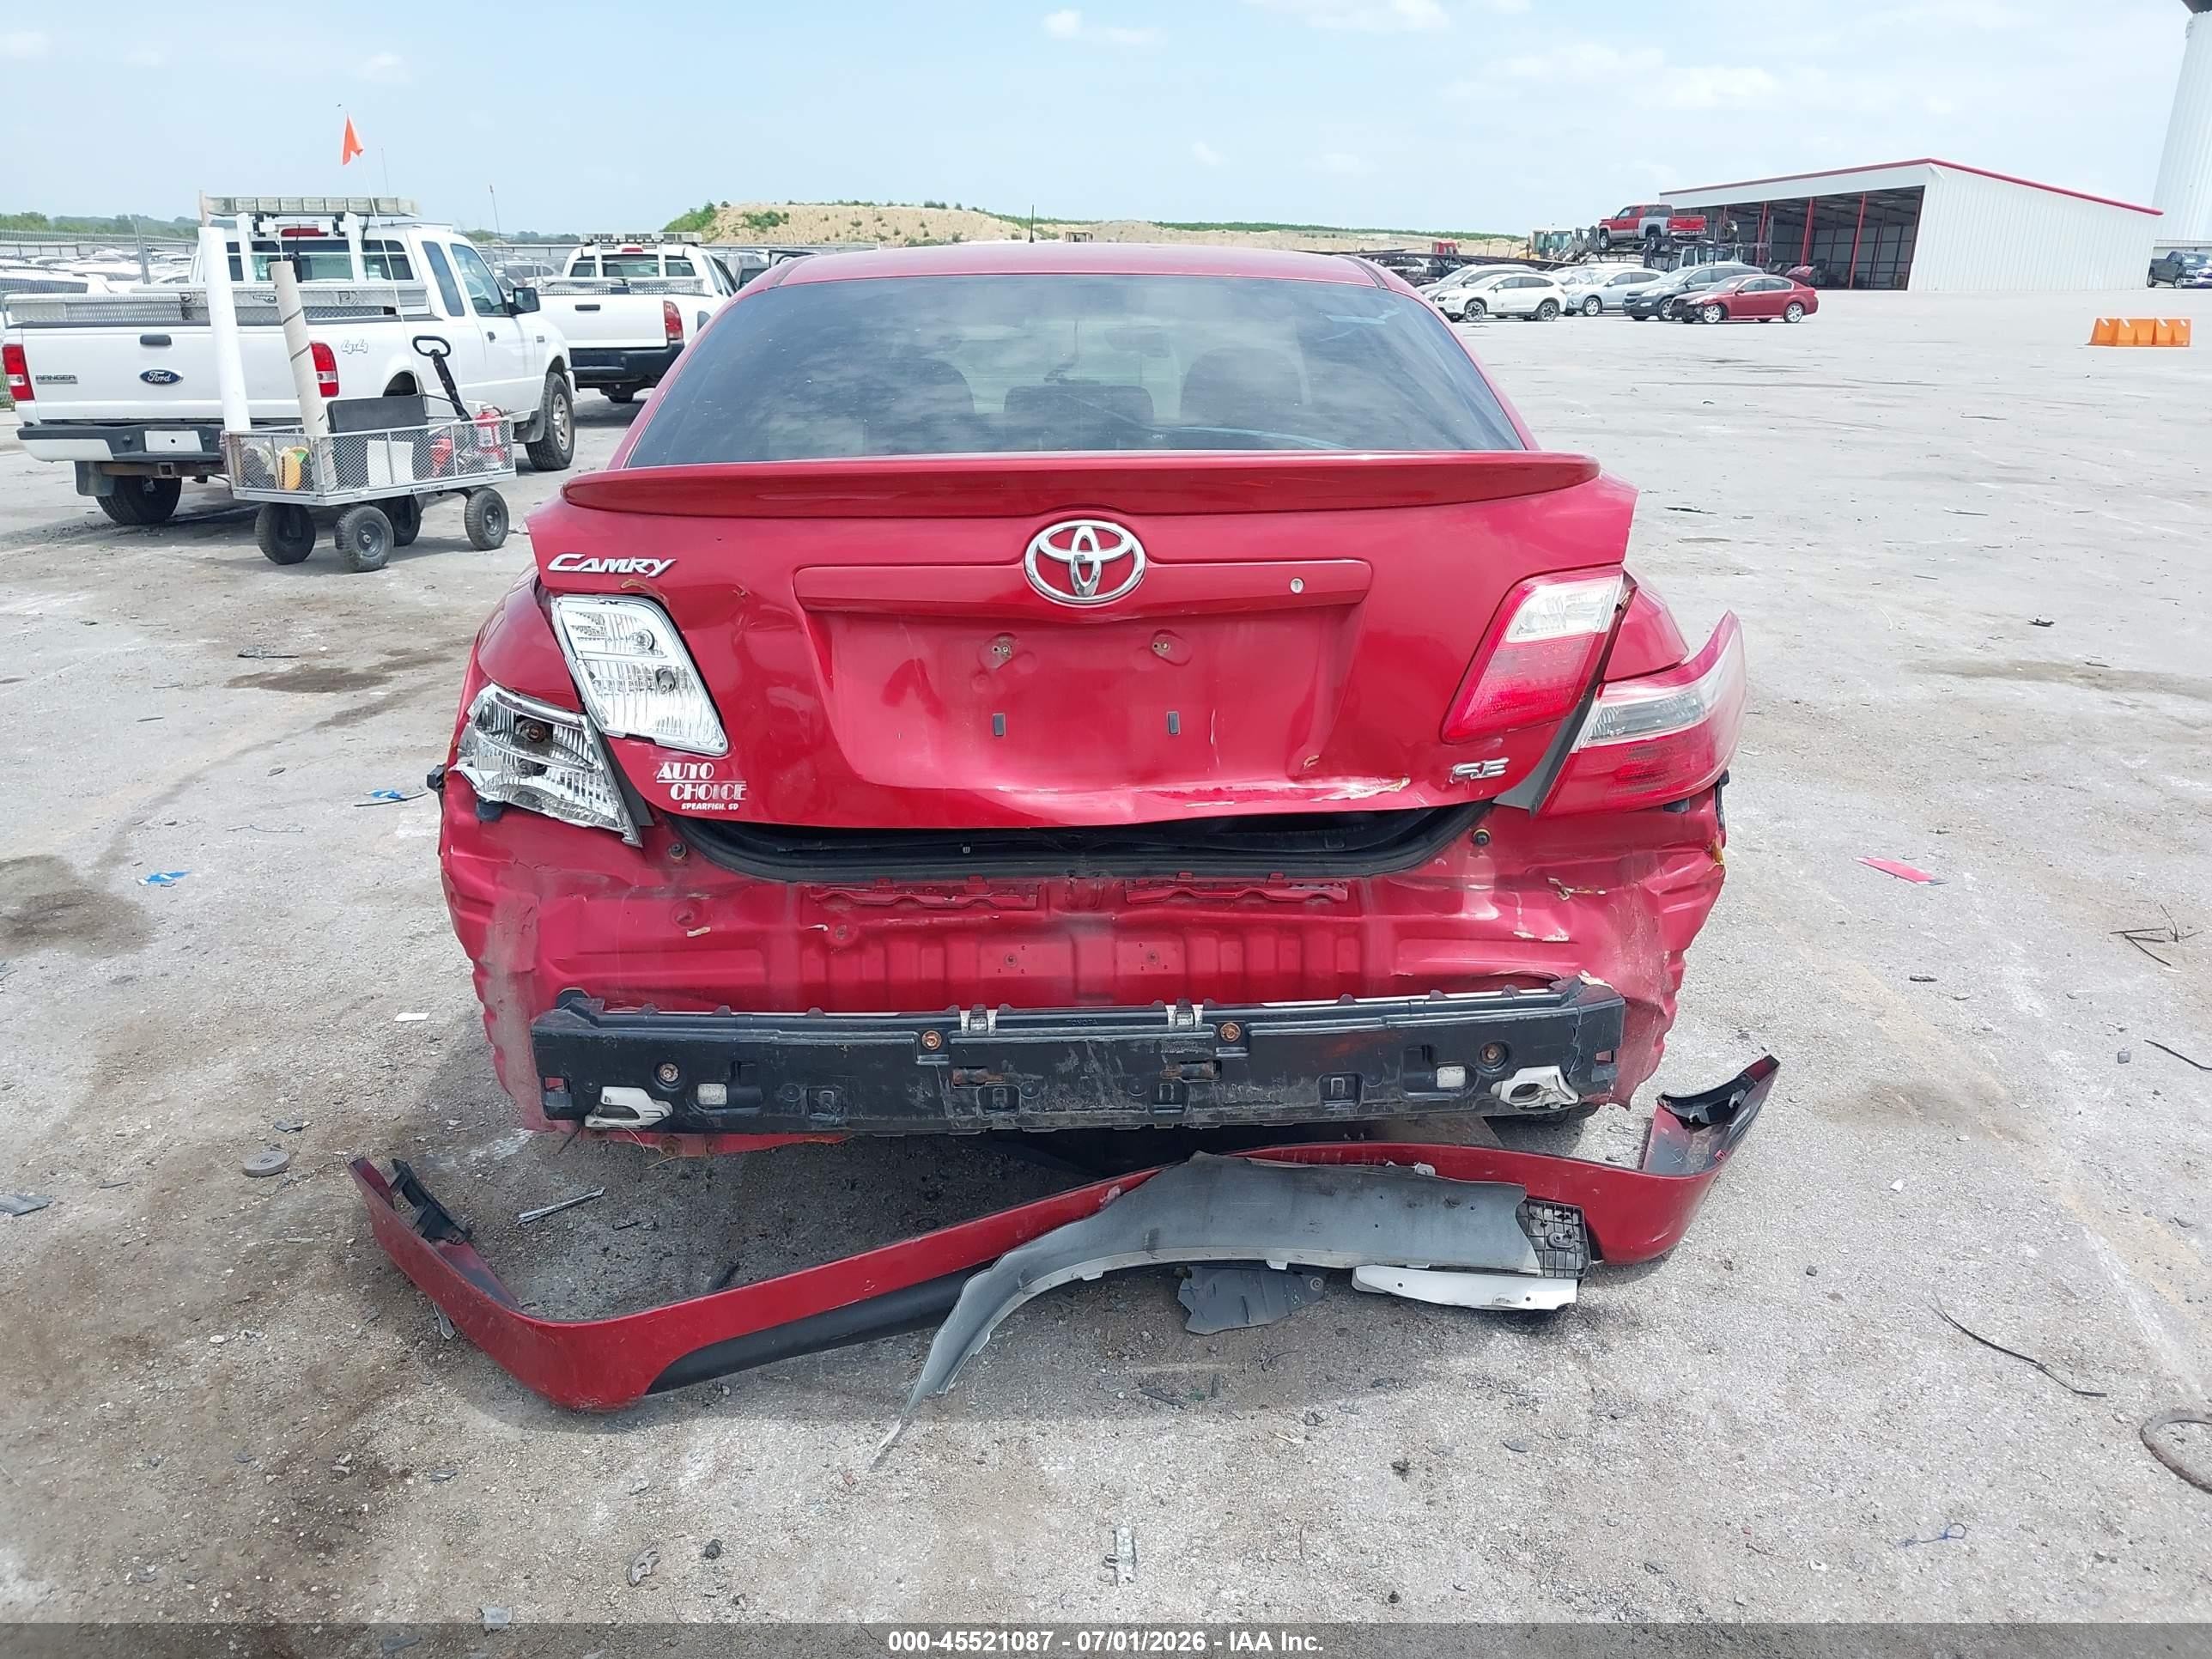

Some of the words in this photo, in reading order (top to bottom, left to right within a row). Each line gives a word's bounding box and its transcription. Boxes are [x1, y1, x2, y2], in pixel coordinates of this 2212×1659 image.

[341, 338, 369, 355] 4x4
[547, 553, 677, 578] CAMRY
[656, 762, 714, 780] AUTO
[1451, 757, 1510, 781] SE
[670, 783, 747, 800] CHOICE
[728, 802, 739, 811] SD
